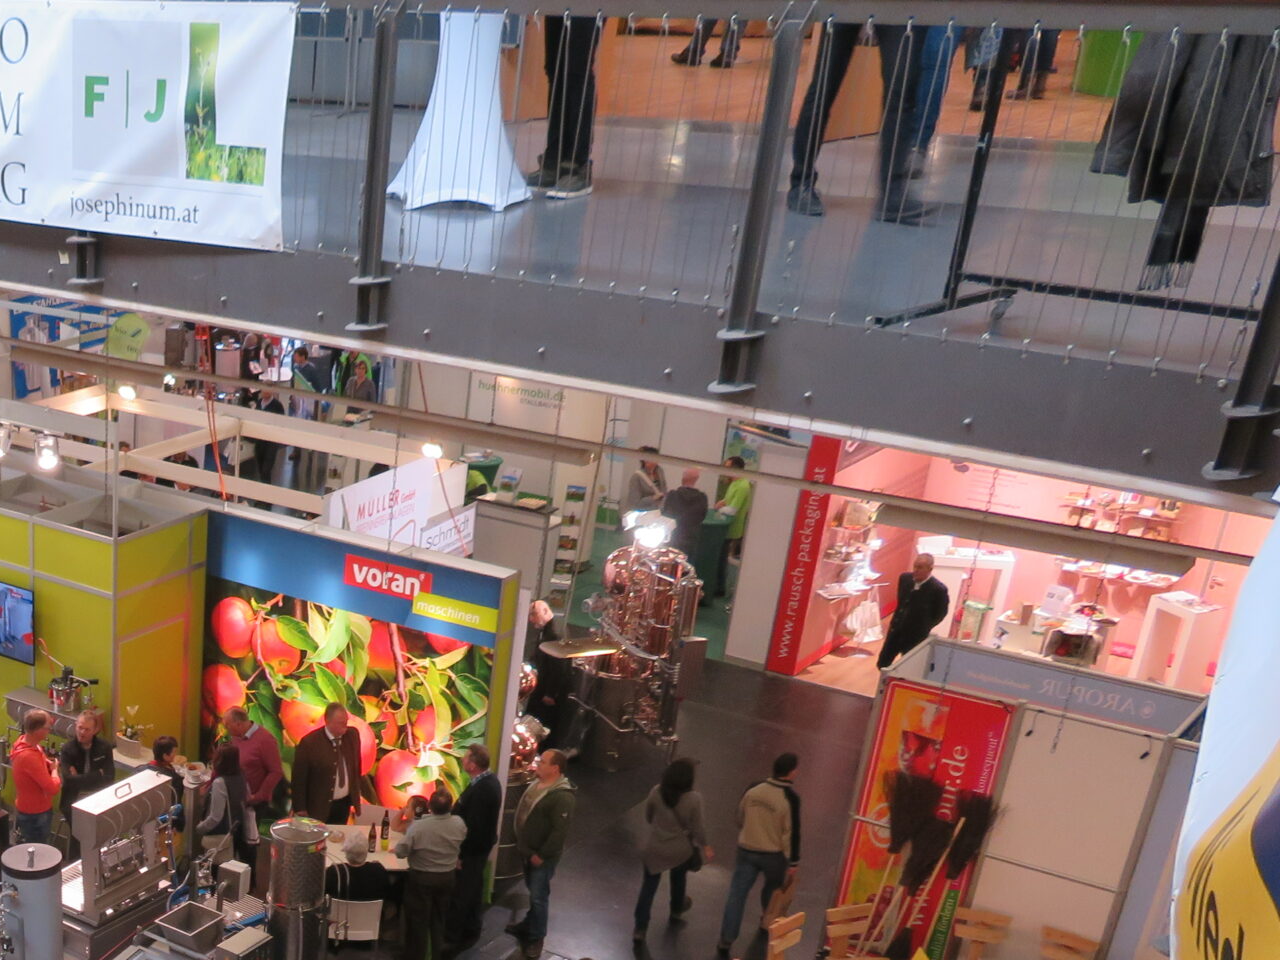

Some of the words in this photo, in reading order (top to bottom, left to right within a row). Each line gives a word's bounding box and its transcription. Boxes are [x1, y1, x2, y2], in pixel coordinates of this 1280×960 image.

[69, 192, 200, 225] josephinum.at
[425, 513, 471, 550] schmidt
[352, 563, 421, 597] voran
[416, 600, 481, 624] maschinen
